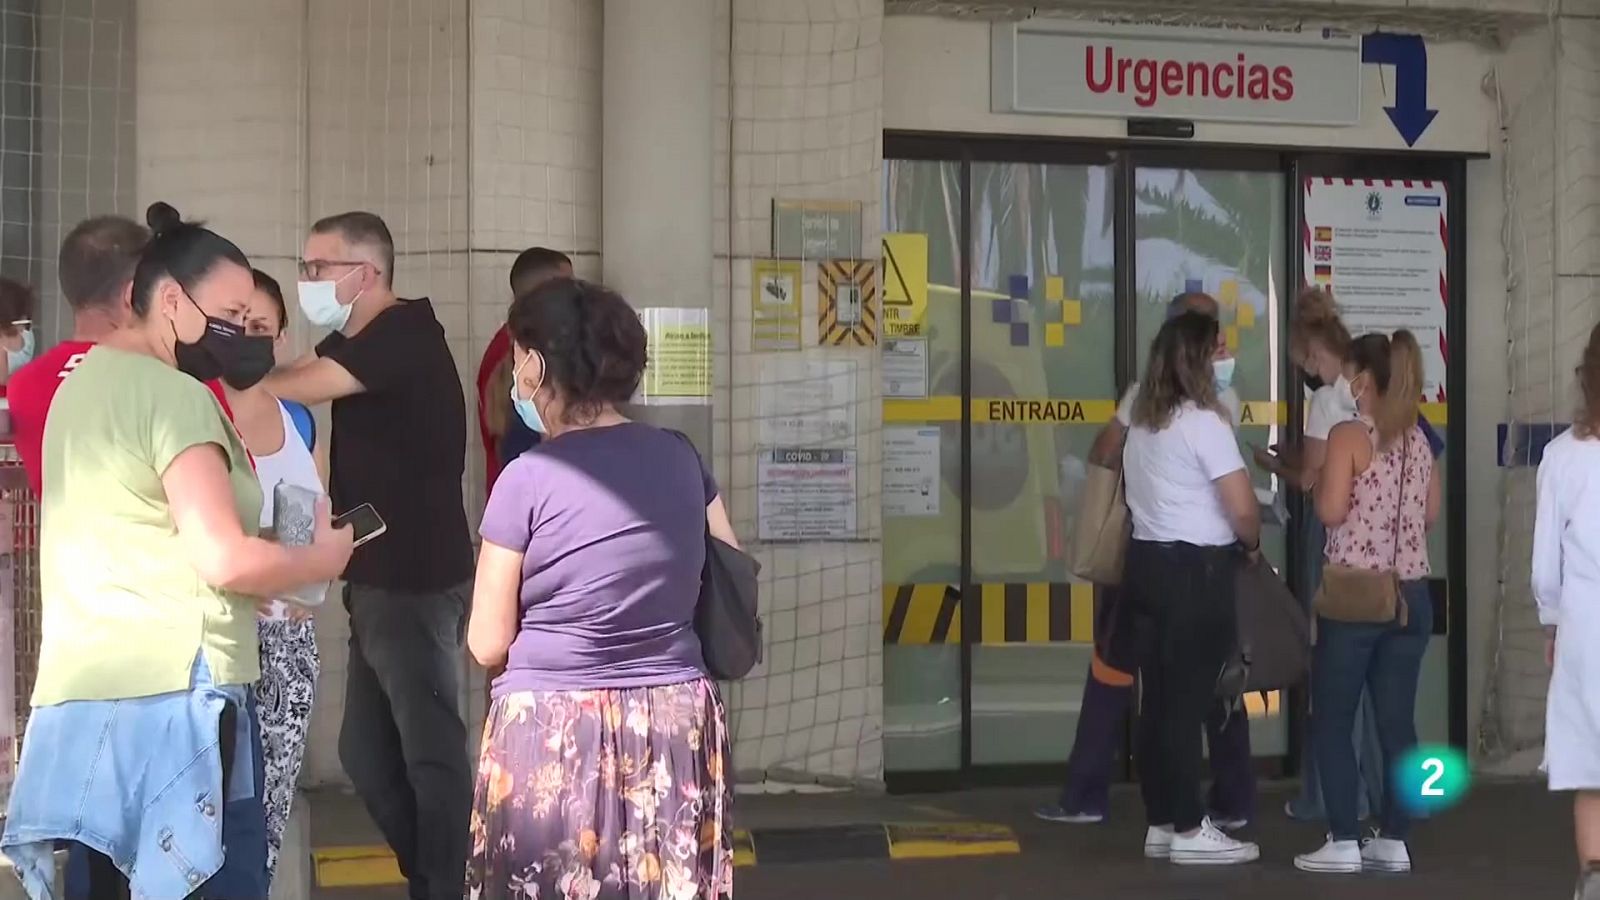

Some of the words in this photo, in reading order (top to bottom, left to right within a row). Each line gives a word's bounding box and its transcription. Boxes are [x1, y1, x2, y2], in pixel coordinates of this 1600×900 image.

[1085, 45, 1294, 108] Urgencias
[989, 401, 1085, 421] ENTRADA
[785, 452, 812, 461] COVID
